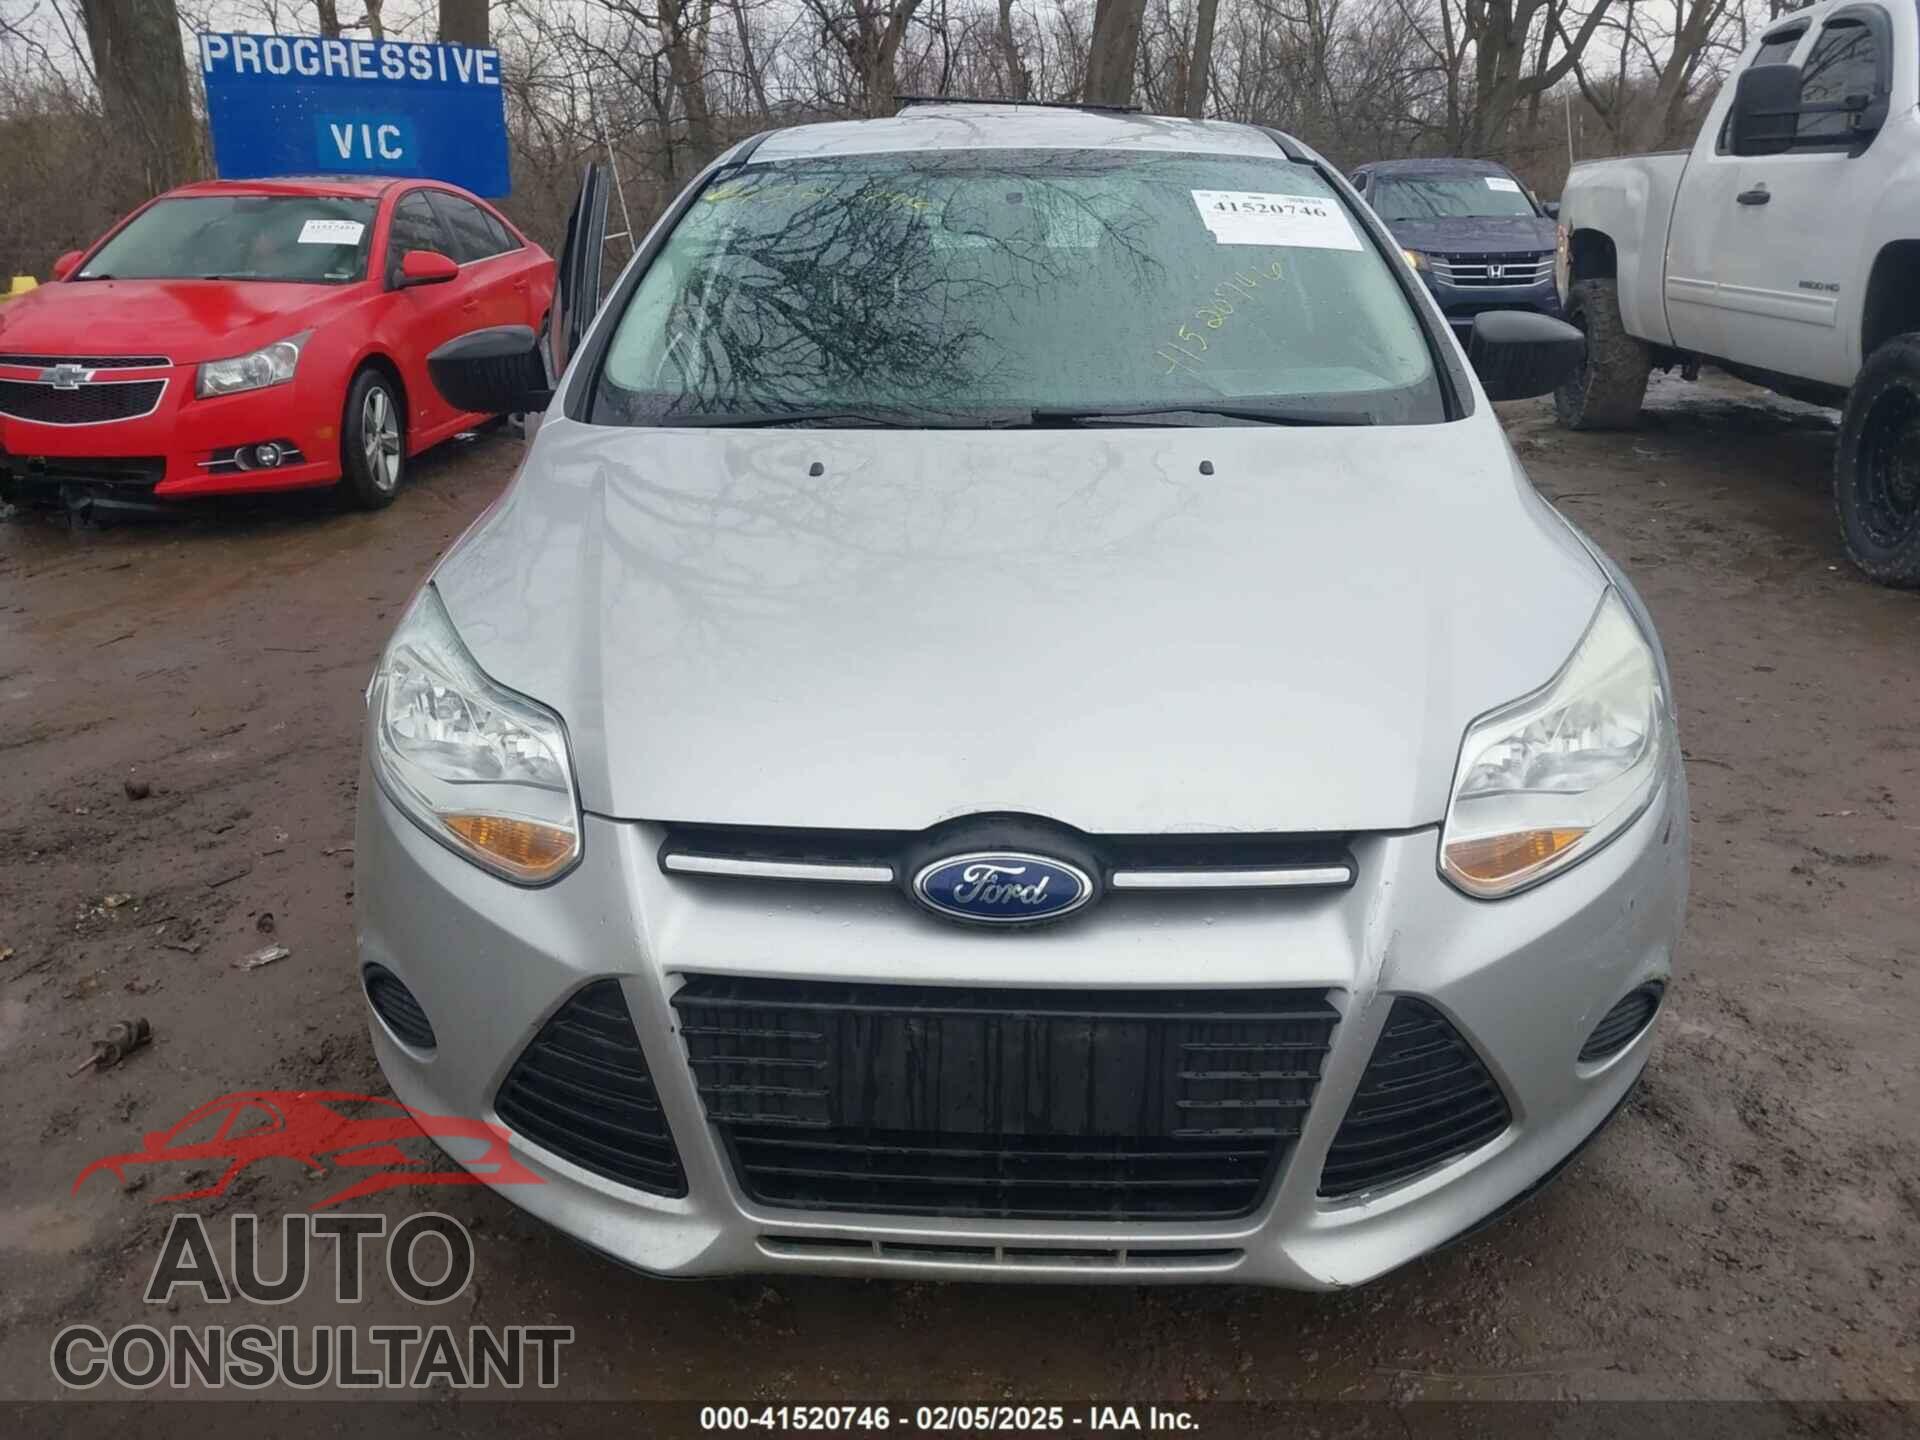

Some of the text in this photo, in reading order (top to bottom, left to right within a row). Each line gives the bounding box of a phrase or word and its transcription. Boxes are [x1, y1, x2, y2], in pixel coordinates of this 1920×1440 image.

[201, 34, 499, 85] PROGRESSIVE
[330, 123, 403, 160] VIC
[1213, 201, 1327, 217] 41520746
[953, 864, 1050, 904] Ford
